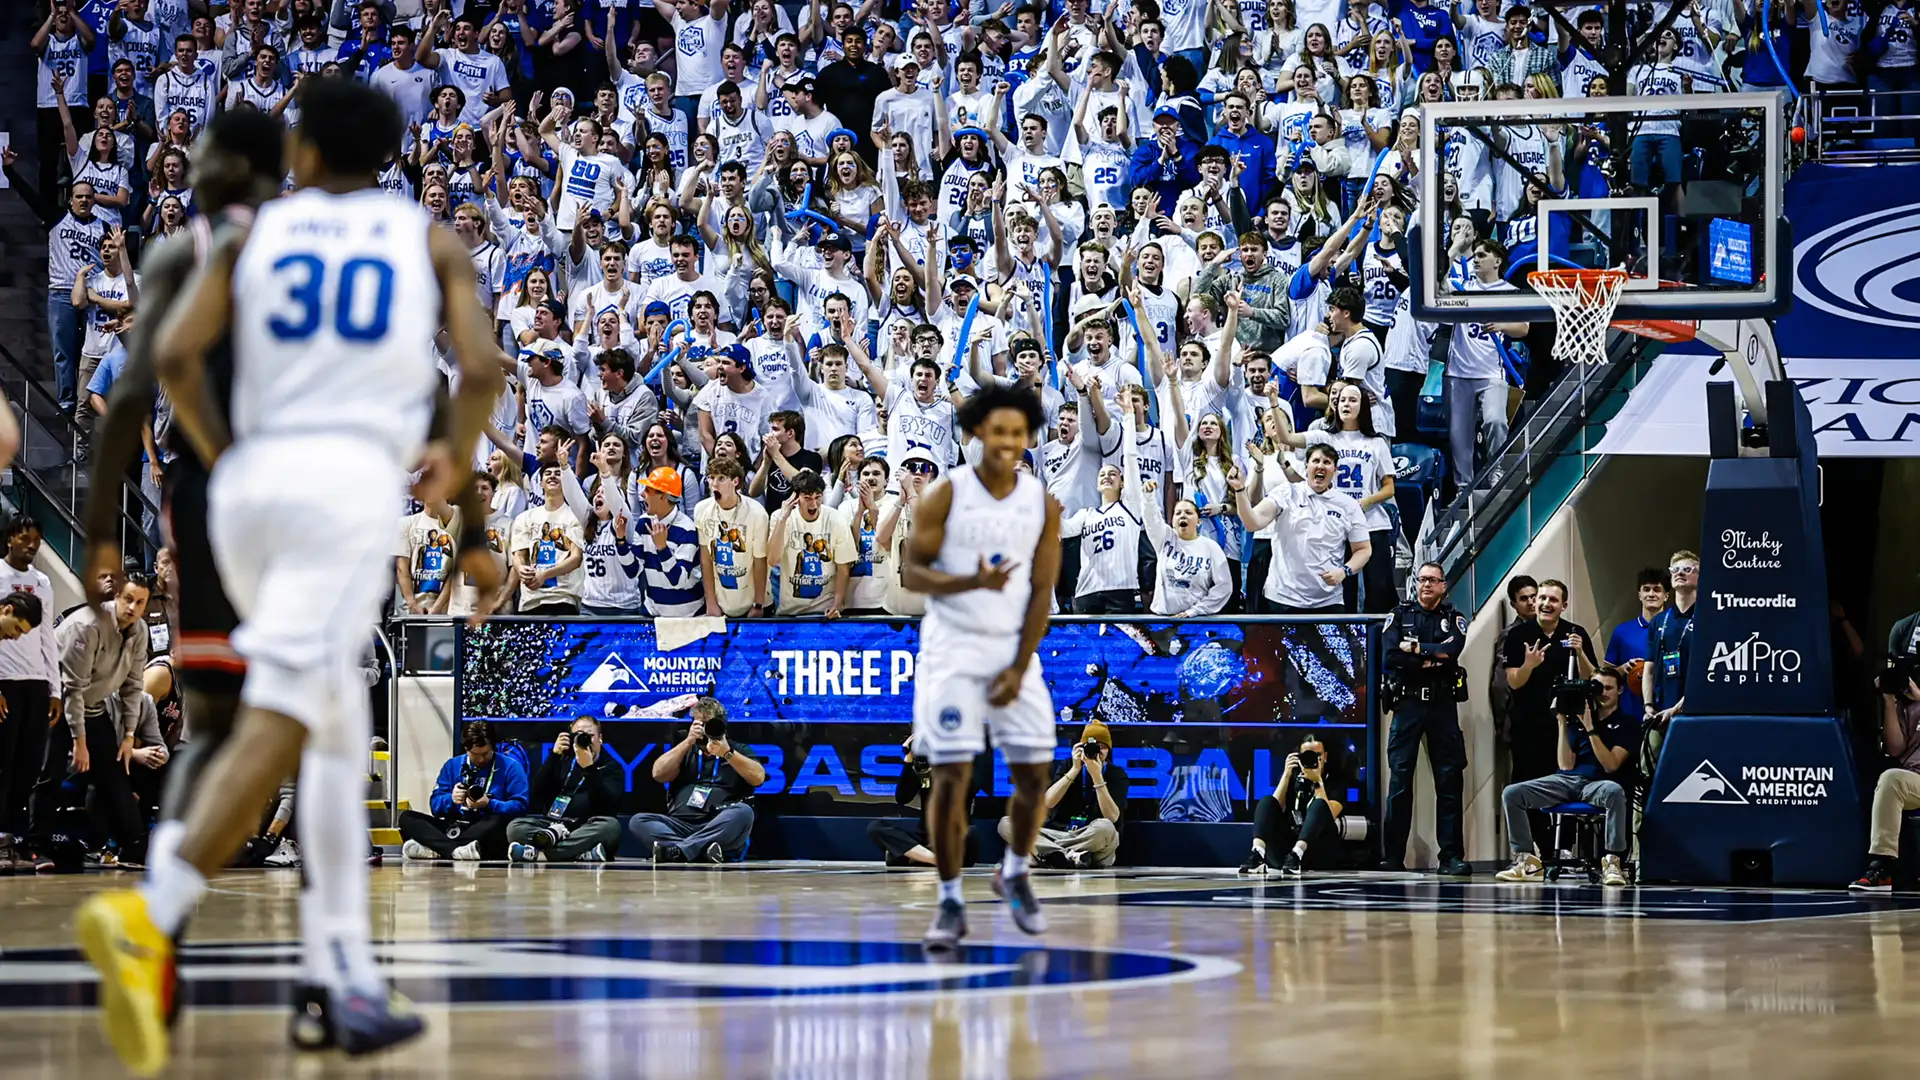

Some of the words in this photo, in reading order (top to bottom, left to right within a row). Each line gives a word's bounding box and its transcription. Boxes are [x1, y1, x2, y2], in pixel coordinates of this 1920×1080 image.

[57, 60, 75, 77] 26
[457, 63, 483, 77] FAITH
[1009, 59, 1029, 71] BY
[167, 95, 206, 109] COUGARS
[772, 100, 791, 117] 26
[735, 146, 742, 160] 3
[571, 159, 600, 181] GO
[1094, 167, 1118, 185] 25
[267, 253, 394, 341] 30
[1374, 281, 1397, 300] 26
[1435, 299, 1469, 308] SPALDING
[1156, 321, 1169, 343] 3
[714, 402, 755, 424] BYU
[900, 415, 947, 445] BYU
[1337, 449, 1372, 463] RIGHAM
[1337, 463, 1364, 488] 24
[1395, 464, 1421, 479] BOARD
[1081, 516, 1126, 540] COUGARS
[1092, 530, 1115, 554] 26
[1721, 528, 1783, 556] Minky
[431, 557, 437, 567] 3
[544, 552, 550, 561] 3
[722, 552, 728, 562] 3
[1722, 550, 1782, 569] Couture
[586, 557, 606, 578] 26
[810, 563, 816, 573] 3
[1725, 592, 1796, 608] Trucordia
[643, 657, 722, 671] MOUNTAIN
[1707, 640, 1801, 672] AllPro
[648, 672, 716, 685] AMERICA
[771, 650, 882, 696] THREE
[1707, 672, 1801, 685] Capital
[1742, 766, 1834, 781] MOUNTAIN
[1747, 783, 1827, 797] AMERICA
